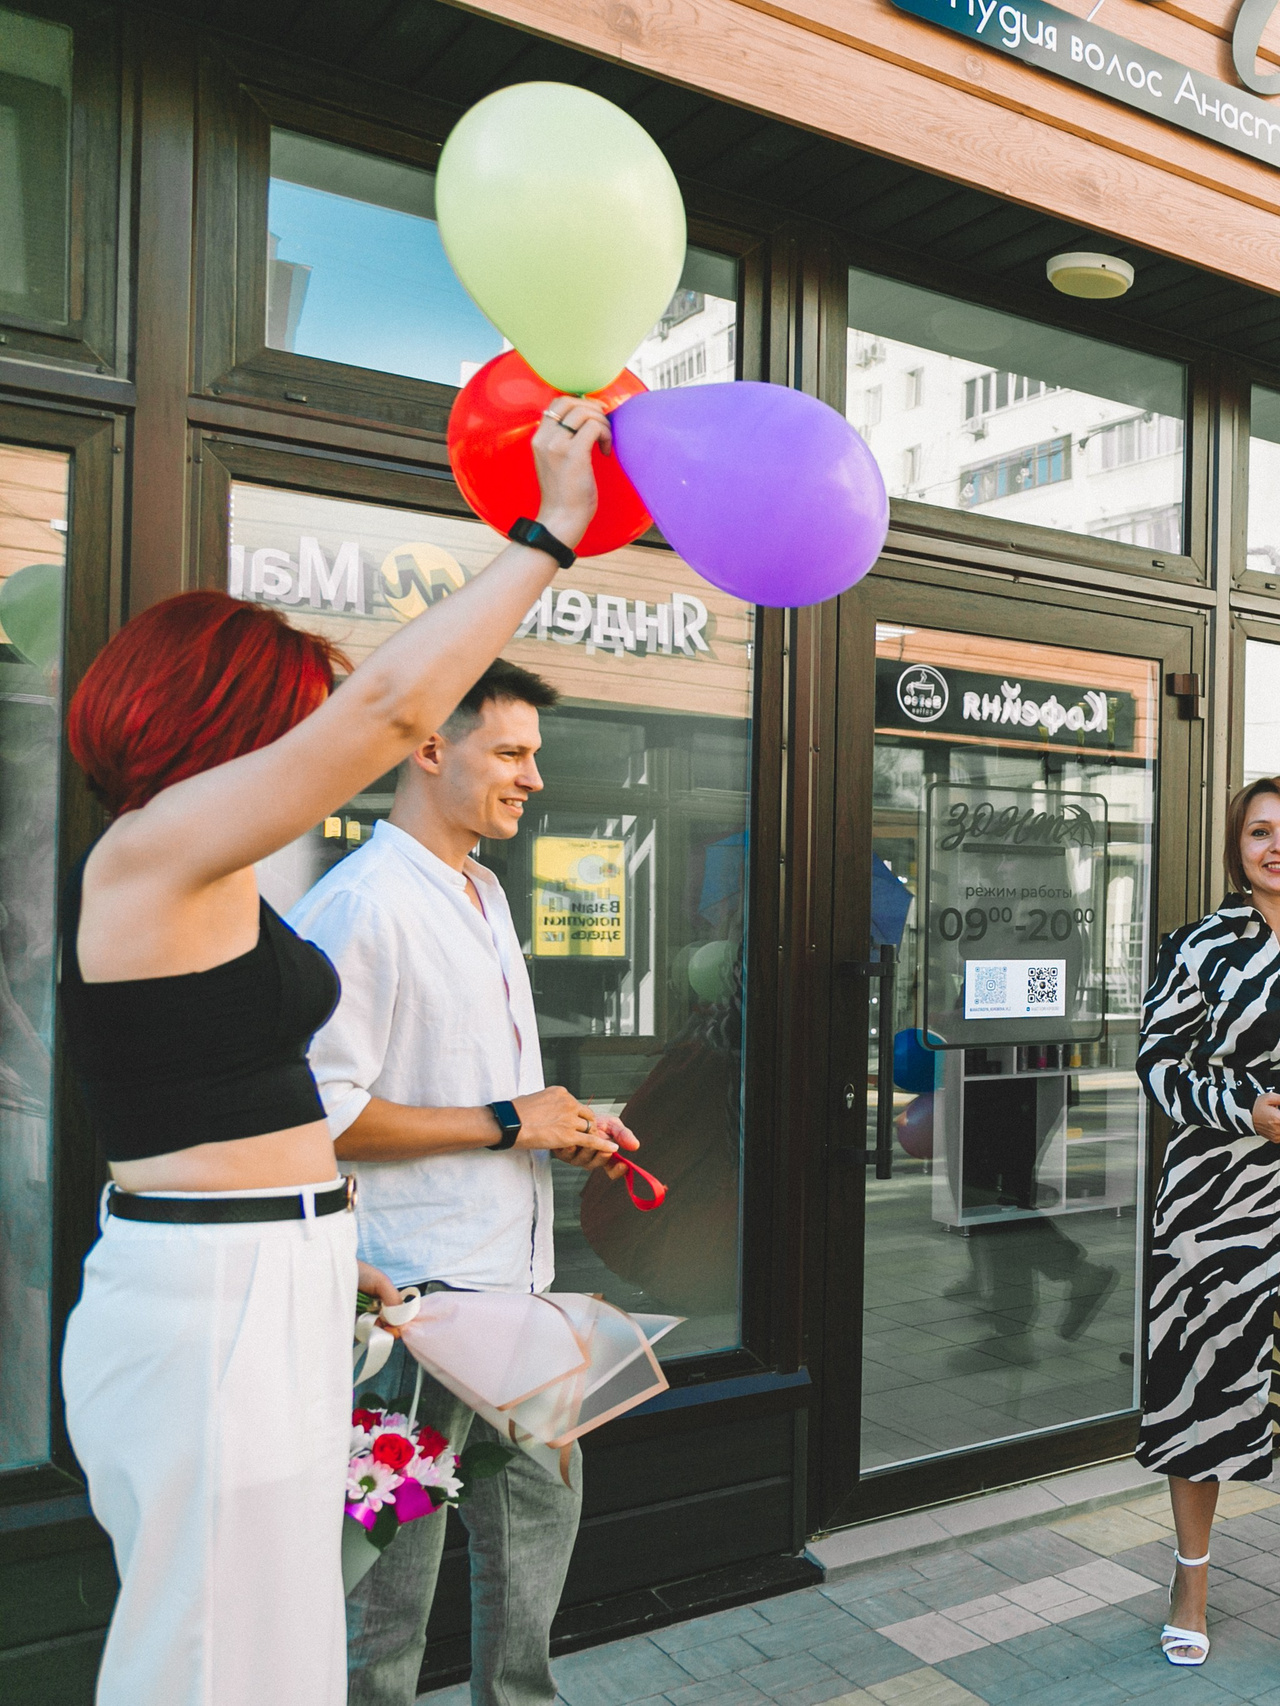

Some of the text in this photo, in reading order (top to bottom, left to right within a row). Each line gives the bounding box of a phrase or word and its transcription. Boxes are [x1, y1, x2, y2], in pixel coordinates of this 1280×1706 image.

[945, 0, 1057, 52] удия
[1070, 35, 1163, 98] волос
[965, 885, 1072, 899] режим работы
